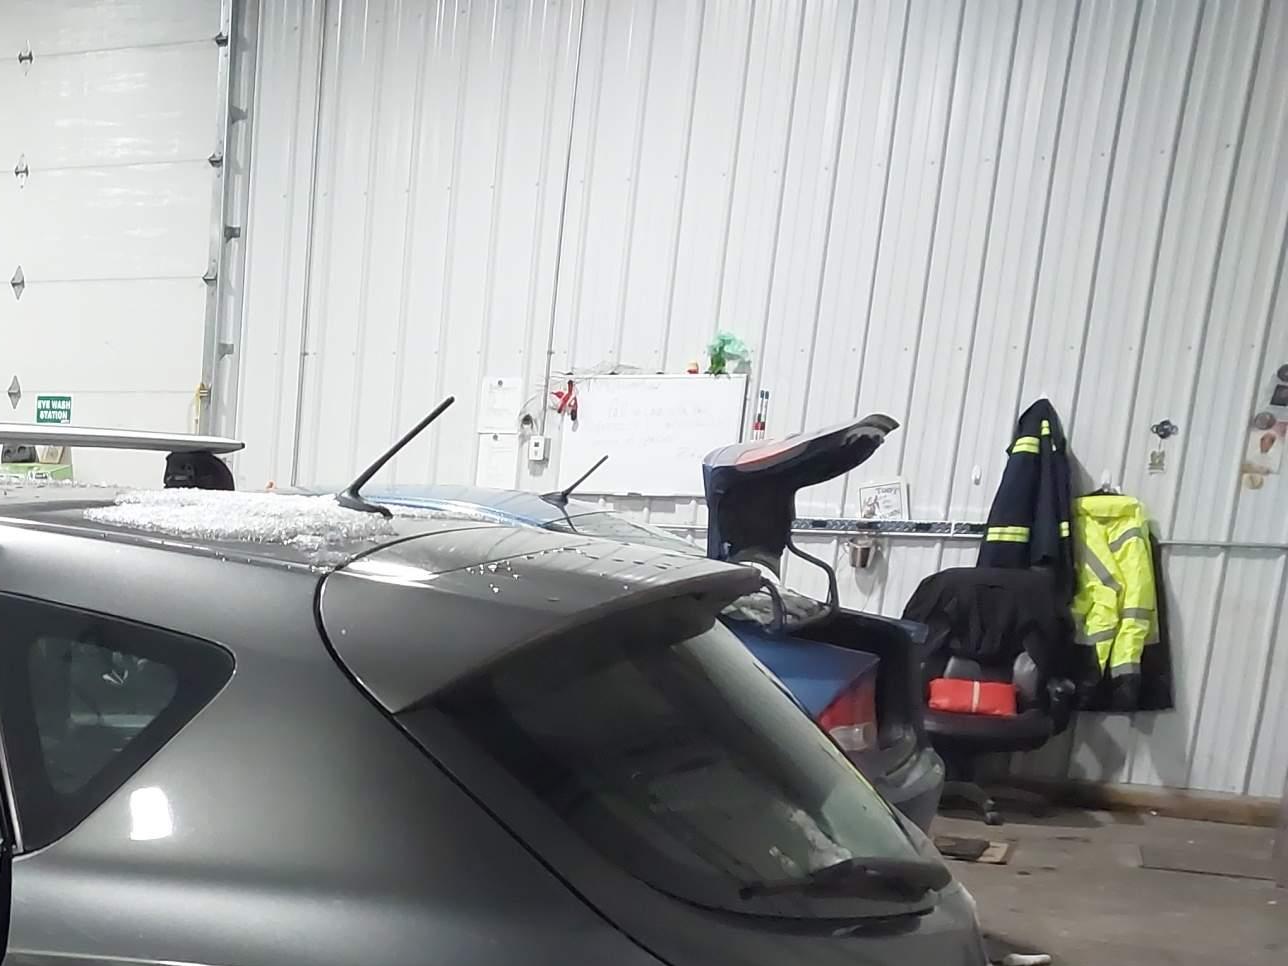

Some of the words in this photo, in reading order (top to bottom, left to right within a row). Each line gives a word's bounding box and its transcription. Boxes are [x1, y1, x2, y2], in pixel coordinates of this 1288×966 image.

[37, 399, 51, 409] EYE
[52, 399, 71, 410] WASH
[39, 410, 68, 420] STATION
